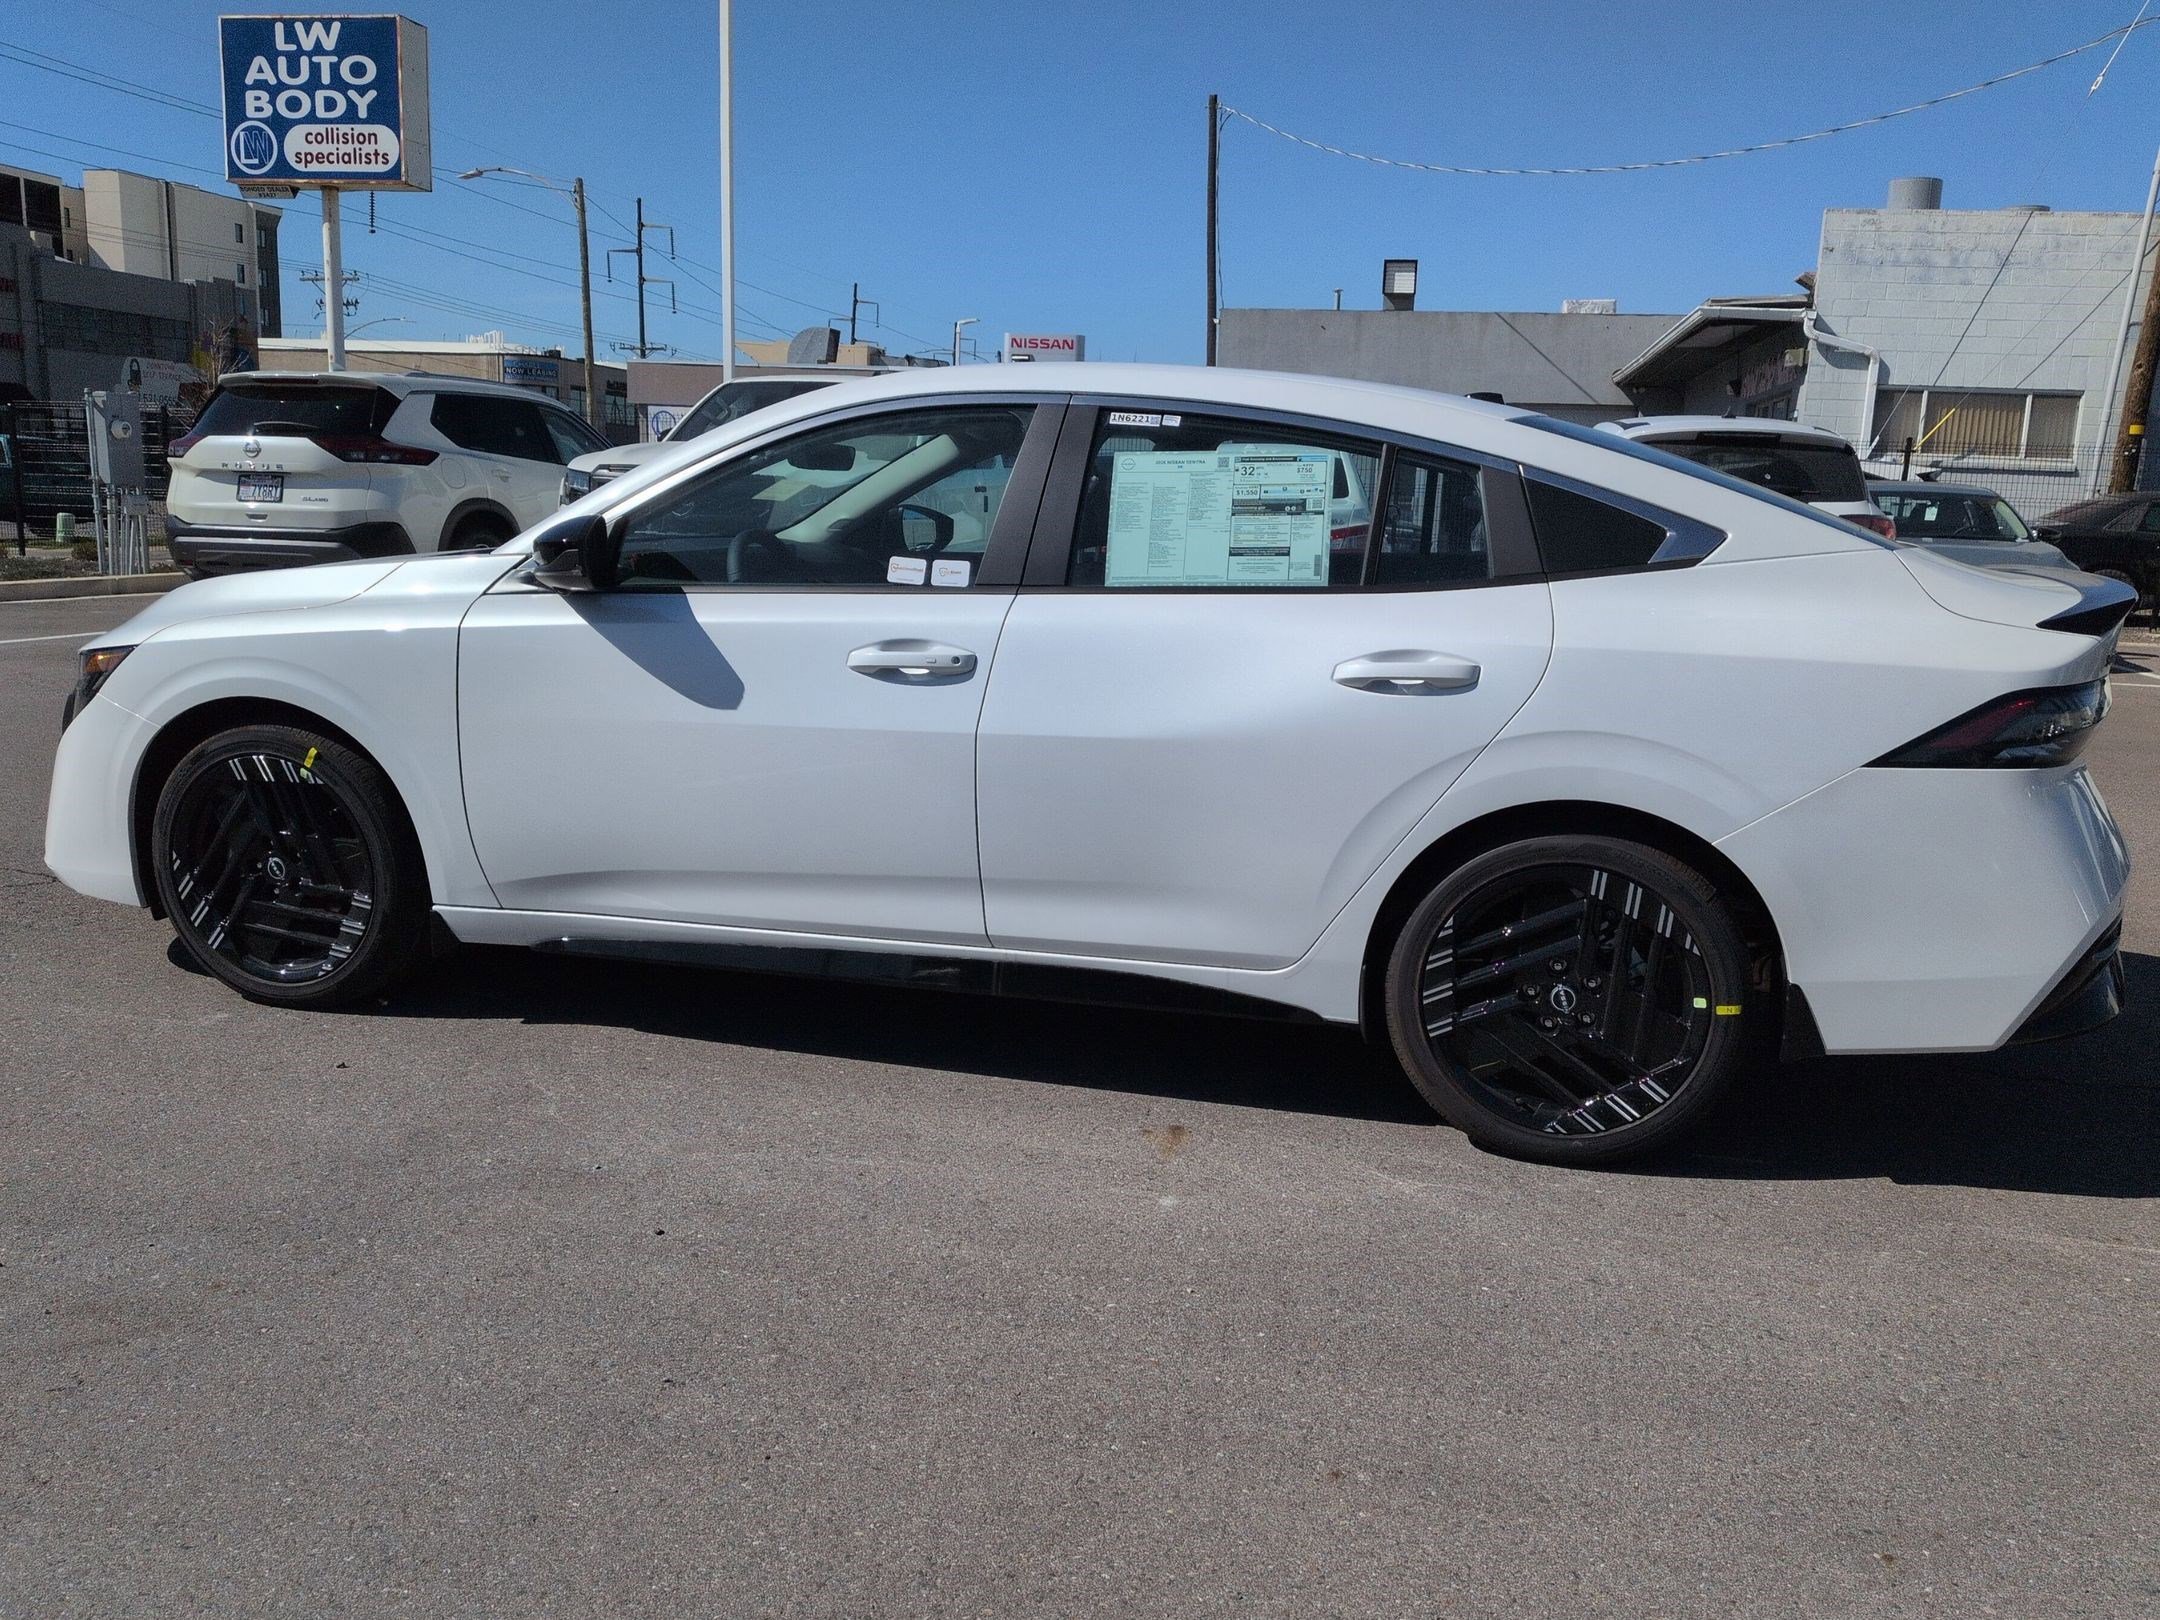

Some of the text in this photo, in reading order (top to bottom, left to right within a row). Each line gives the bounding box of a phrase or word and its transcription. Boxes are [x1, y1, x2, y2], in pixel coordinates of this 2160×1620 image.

[275, 21, 341, 51] LW
[245, 54, 377, 86] AUTO
[245, 89, 378, 119] BODY
[304, 127, 378, 146] collision
[294, 147, 390, 169] specialists
[1010, 337, 1074, 350] NISSAN
[1111, 413, 1150, 423] 1N6221
[1241, 466, 1255, 476] 32
